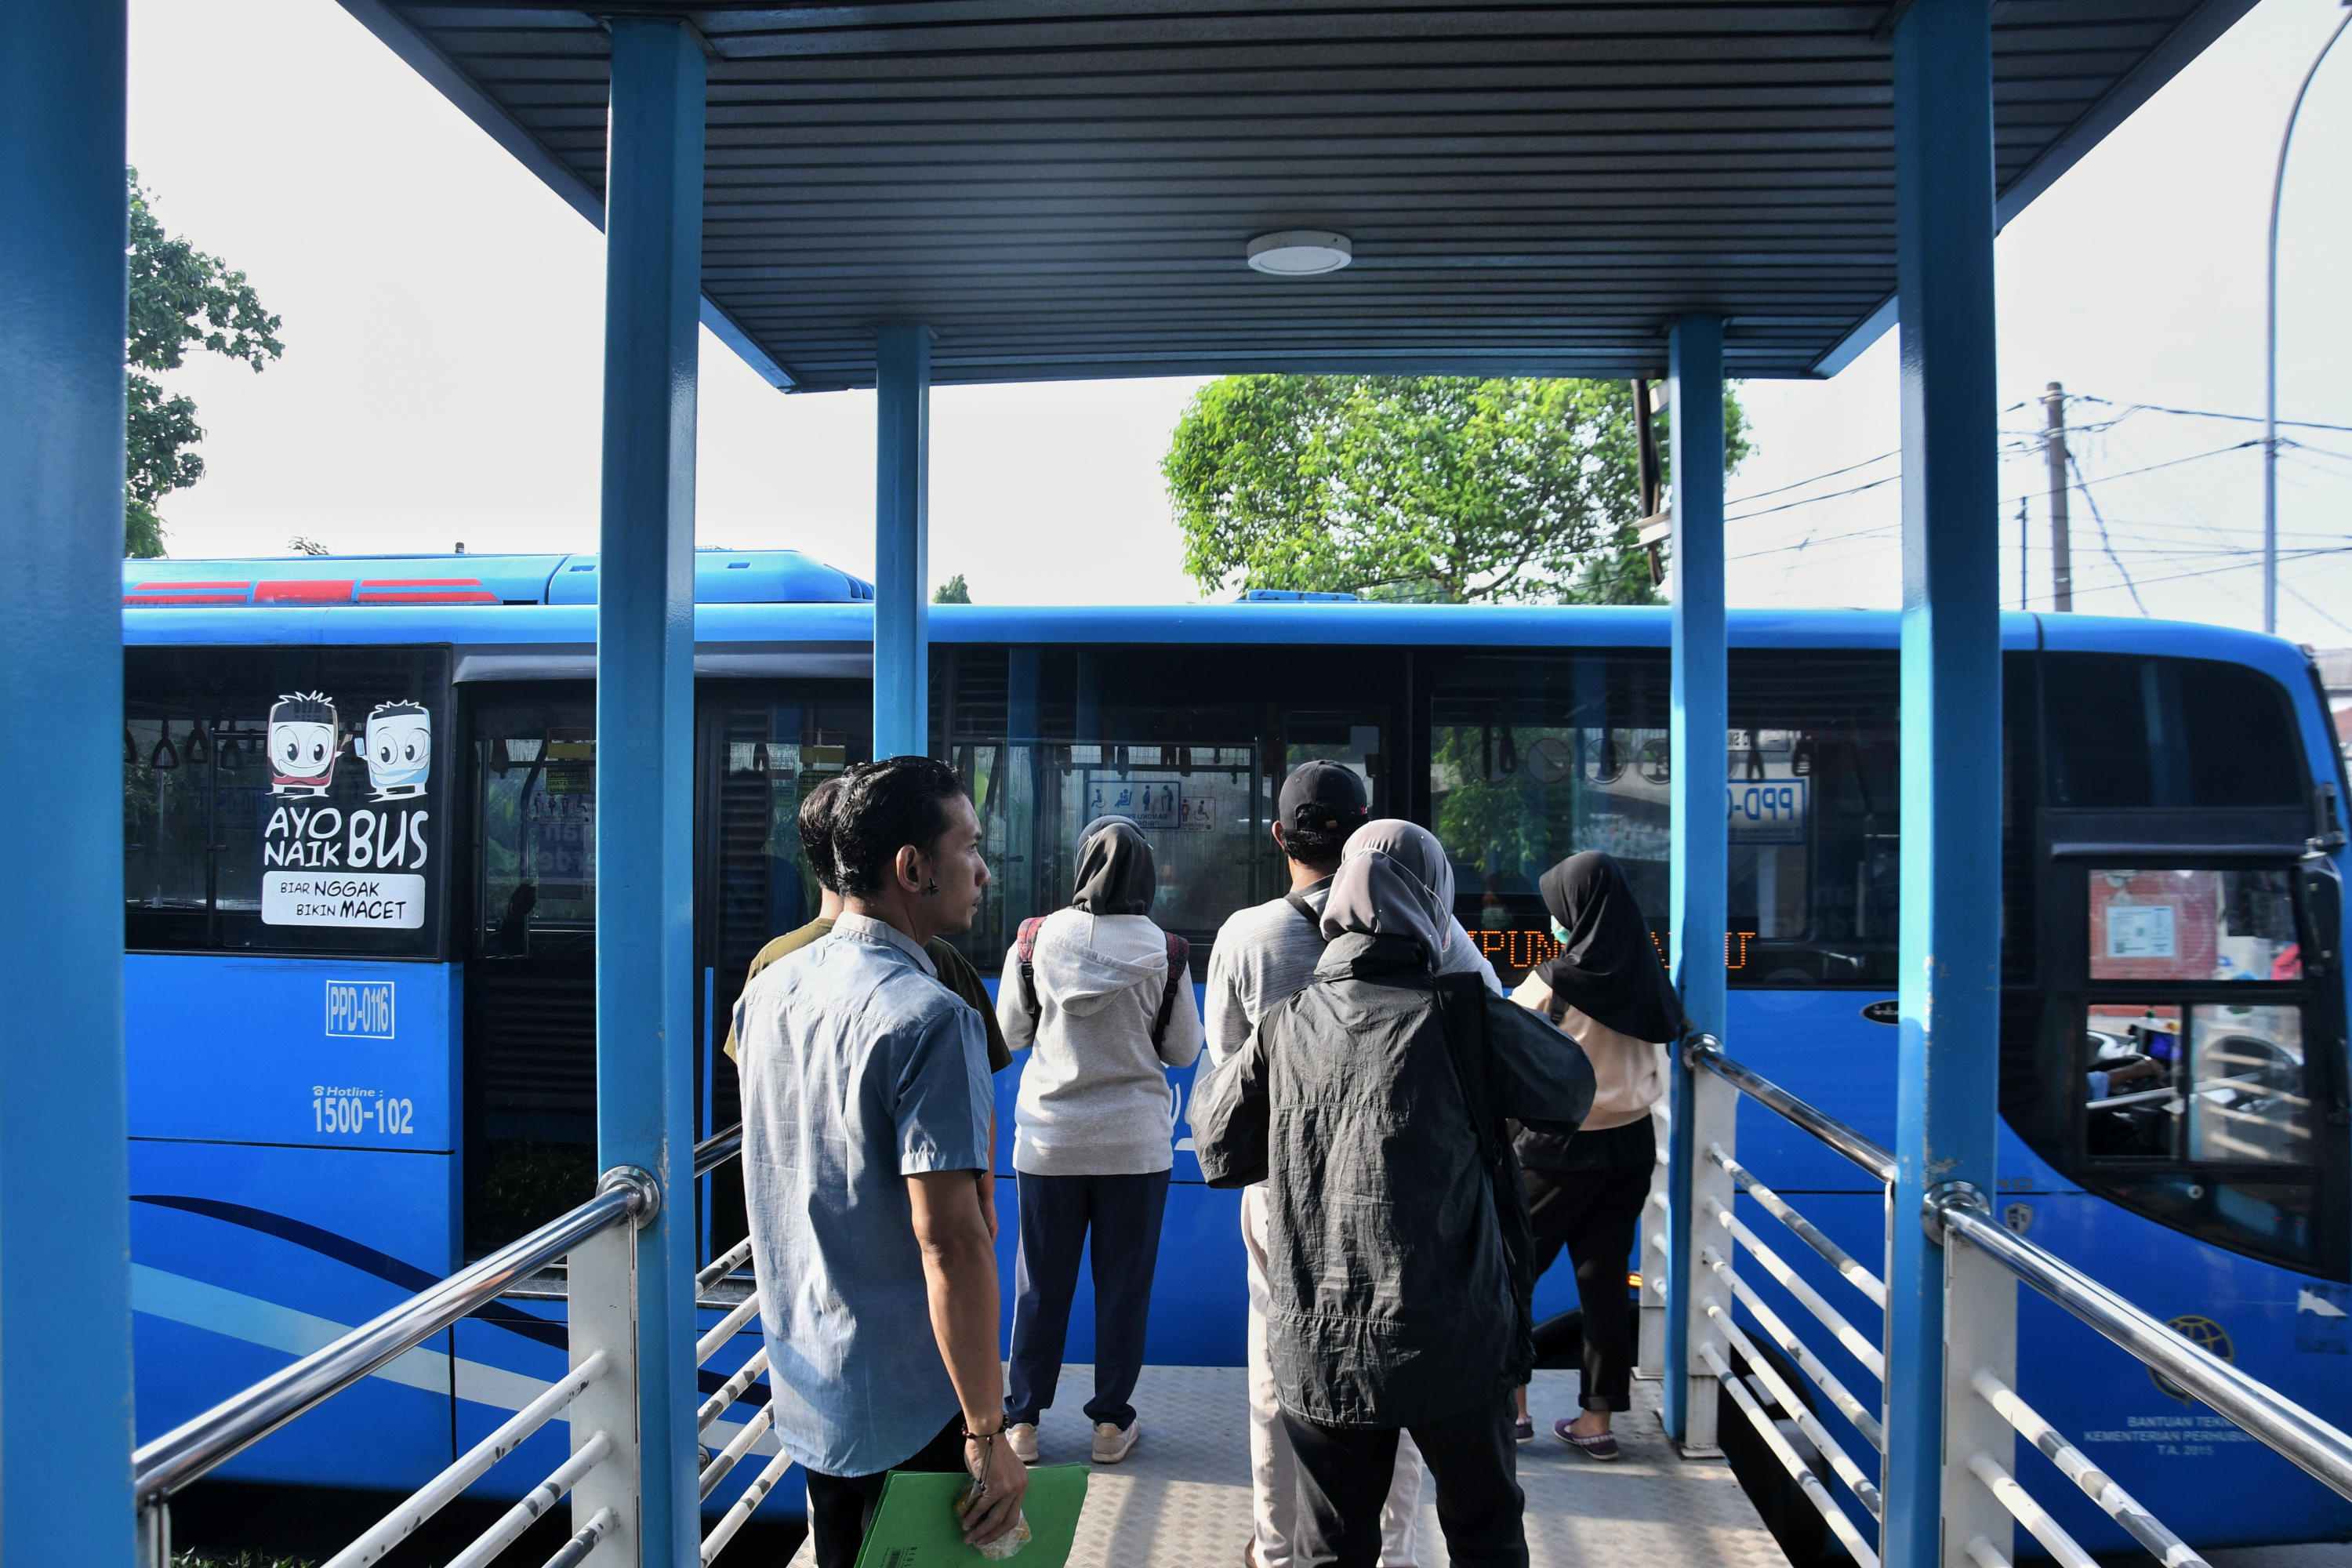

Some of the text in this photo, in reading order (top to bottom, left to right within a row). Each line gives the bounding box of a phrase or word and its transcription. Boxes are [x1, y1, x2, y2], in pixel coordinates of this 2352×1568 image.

[264, 806, 342, 839] AYO
[347, 809, 429, 869] BUS
[264, 840, 342, 867] NAIK
[279, 880, 381, 898] BIAR NGGAK
[296, 900, 408, 920] BIKIN MACET
[329, 985, 390, 1033] PPD-0116
[326, 1086, 376, 1098] Hotline
[313, 1097, 414, 1134] 1500-102
[2127, 1416, 2194, 1428] BANTUAN
[2083, 1430, 2180, 1442] KEMENTERIAN
